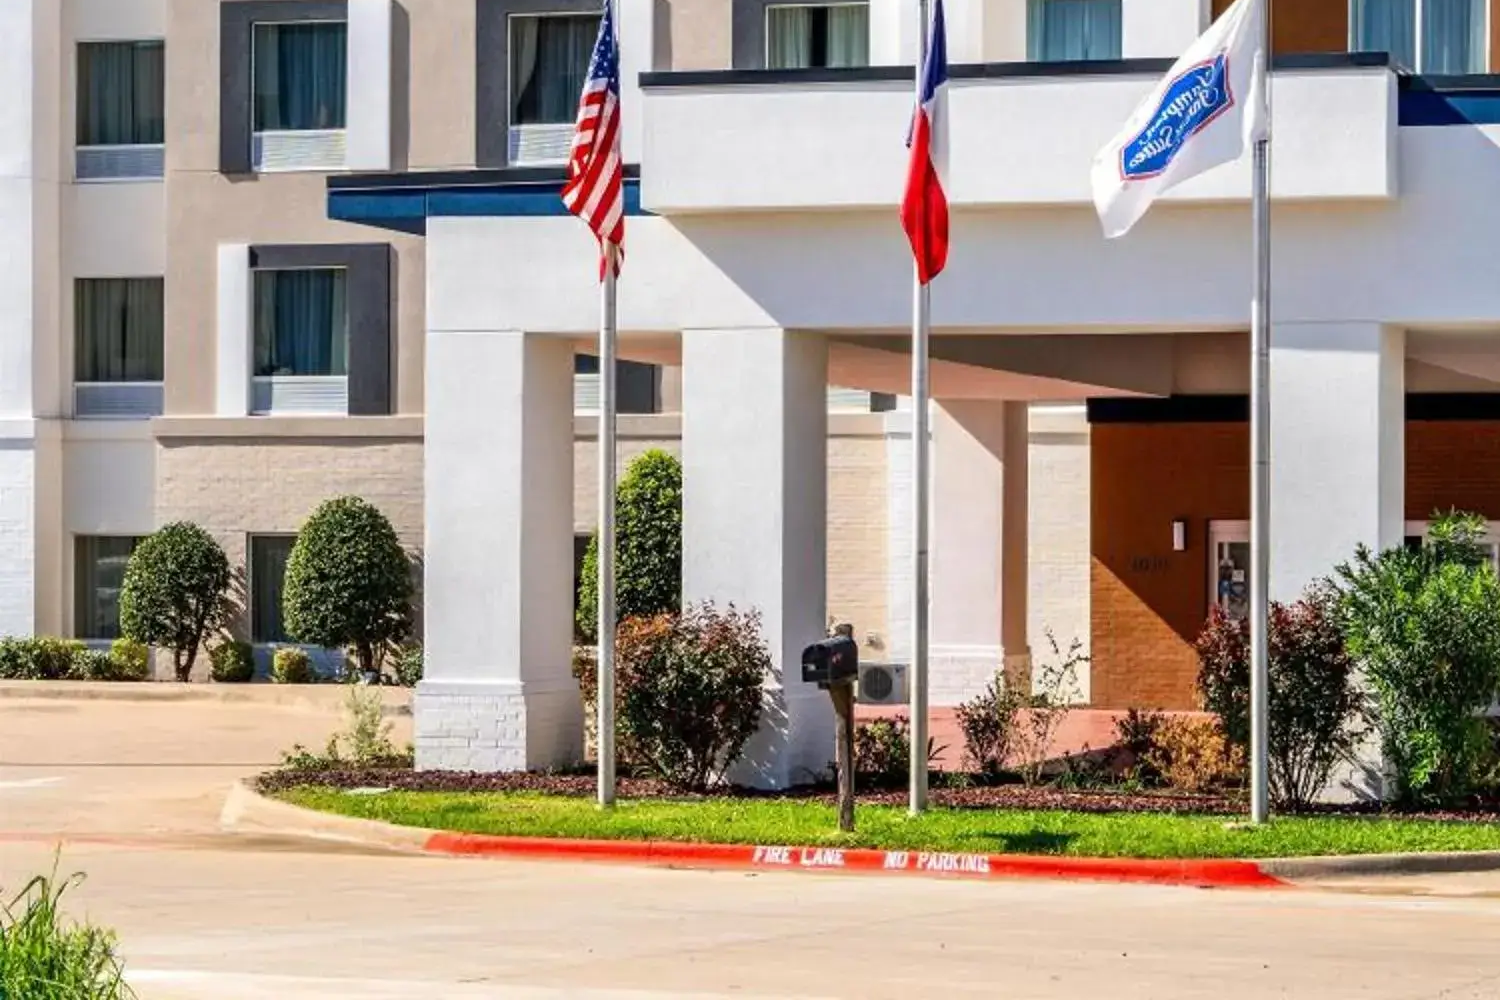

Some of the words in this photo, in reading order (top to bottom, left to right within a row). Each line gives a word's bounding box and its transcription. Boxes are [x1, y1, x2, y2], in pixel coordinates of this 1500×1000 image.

[752, 846, 790, 865] FIRE
[800, 848, 845, 866] LANE
[883, 851, 908, 869] NO
[916, 852, 990, 873] PARKING
